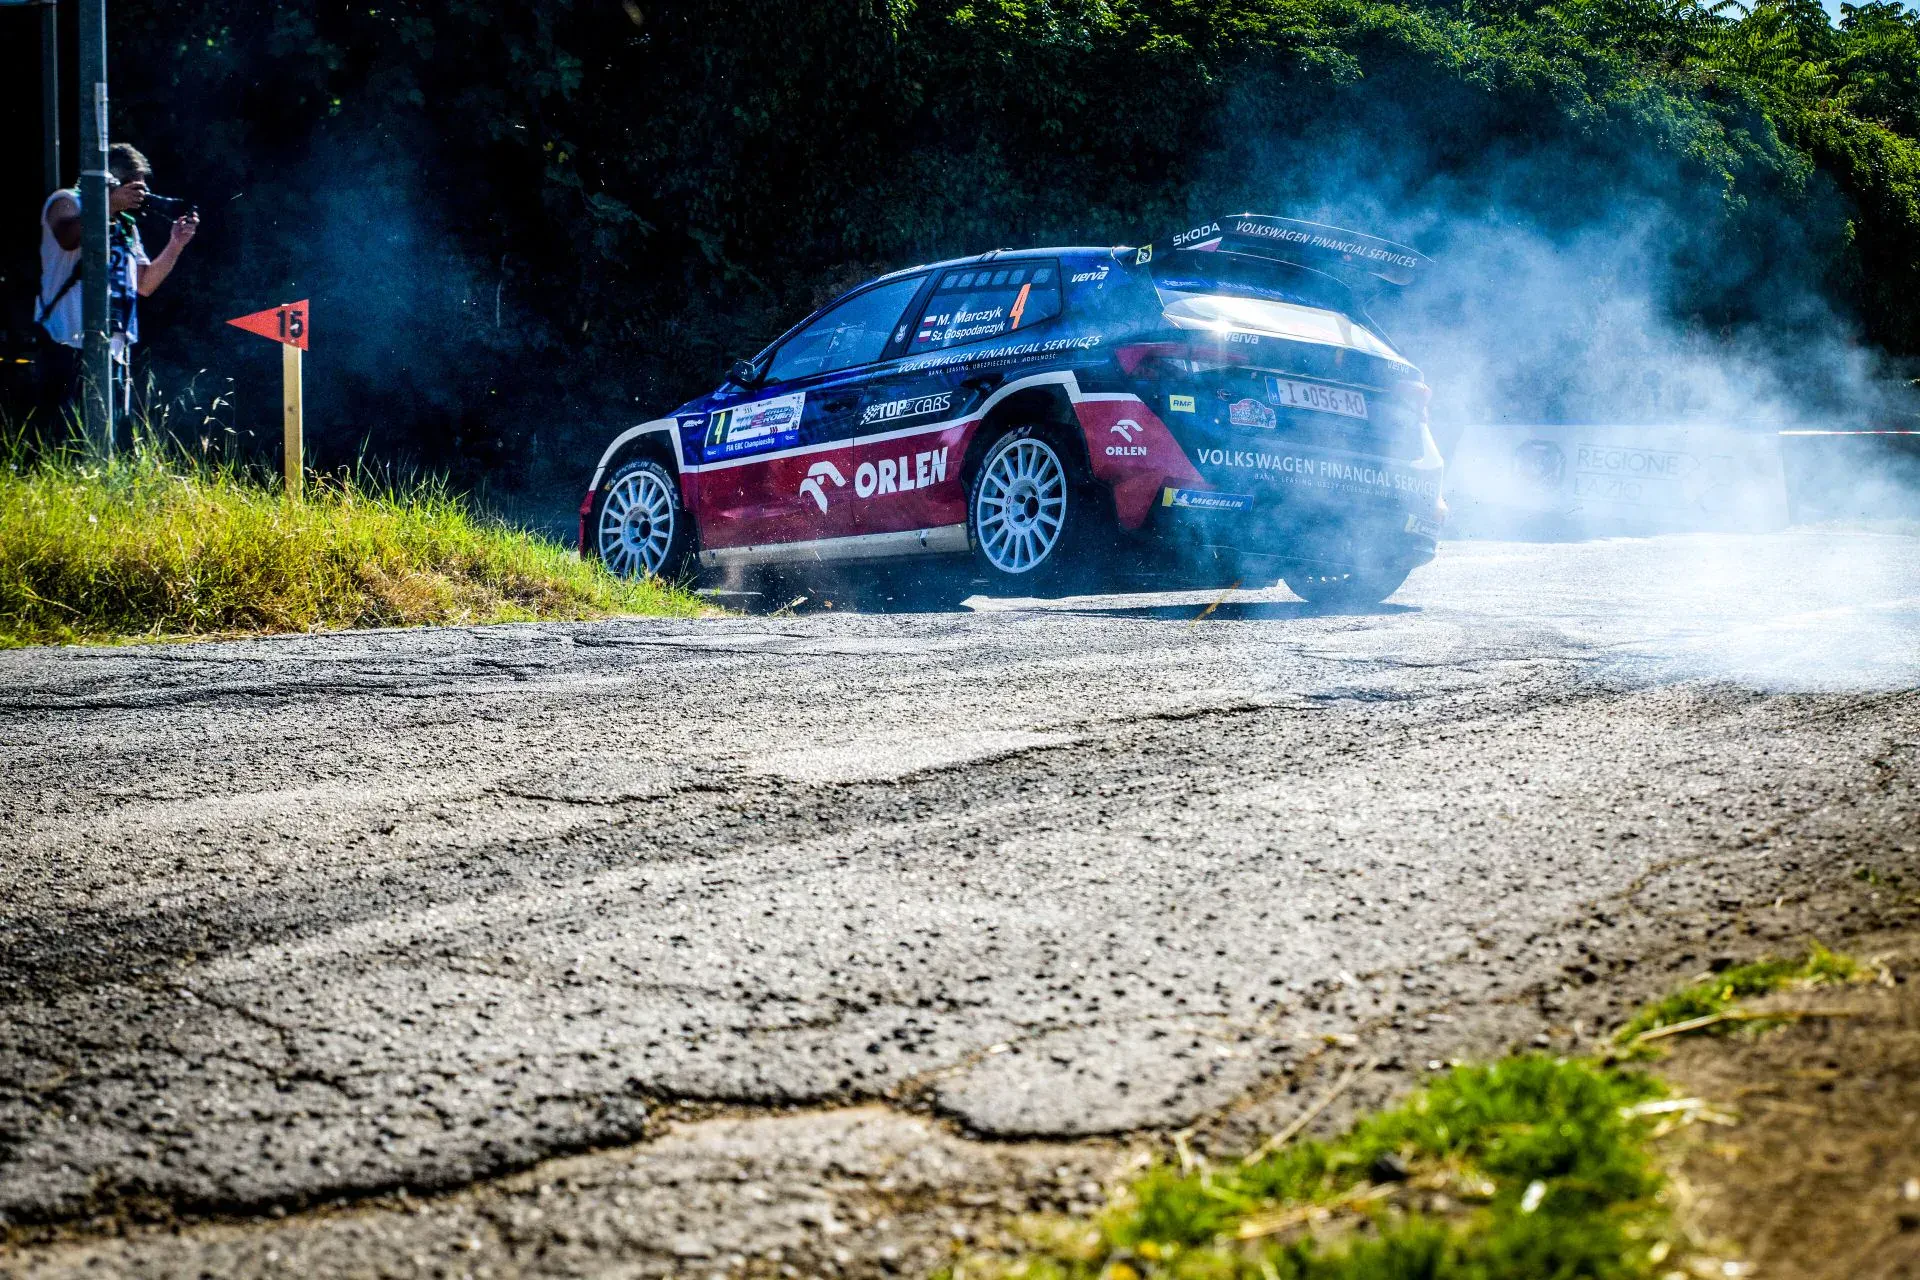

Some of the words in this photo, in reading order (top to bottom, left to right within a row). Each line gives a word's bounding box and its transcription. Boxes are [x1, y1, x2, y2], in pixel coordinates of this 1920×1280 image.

[1235, 220, 1311, 244] VOLKSWAGEN
[1310, 236, 1366, 256] FINANCIAL
[1367, 248, 1417, 268] SERVICES
[937, 314, 950, 326] M.
[953, 306, 1003, 327] Marczyk
[1009, 283, 1031, 330] 4
[276, 310, 304, 339] 15
[944, 321, 1005, 340] Gospodarczyk
[898, 352, 975, 373] VOLKSWAGEN
[976, 342, 1040, 361] FINANCIAL
[1044, 335, 1103, 351] SERVICES
[914, 395, 951, 415] CARS
[1172, 399, 1192, 408] RMF
[714, 412, 727, 445] 4
[1105, 446, 1147, 456] ORLEN
[1577, 448, 1679, 475] REGIONE
[855, 446, 948, 498] ORLEN
[1197, 448, 1314, 475] VOLKSWAGEN
[1320, 461, 1391, 487] FINANCIAL
[1190, 497, 1244, 508] MICHELIN
[1574, 478, 1642, 500] LAZIO
